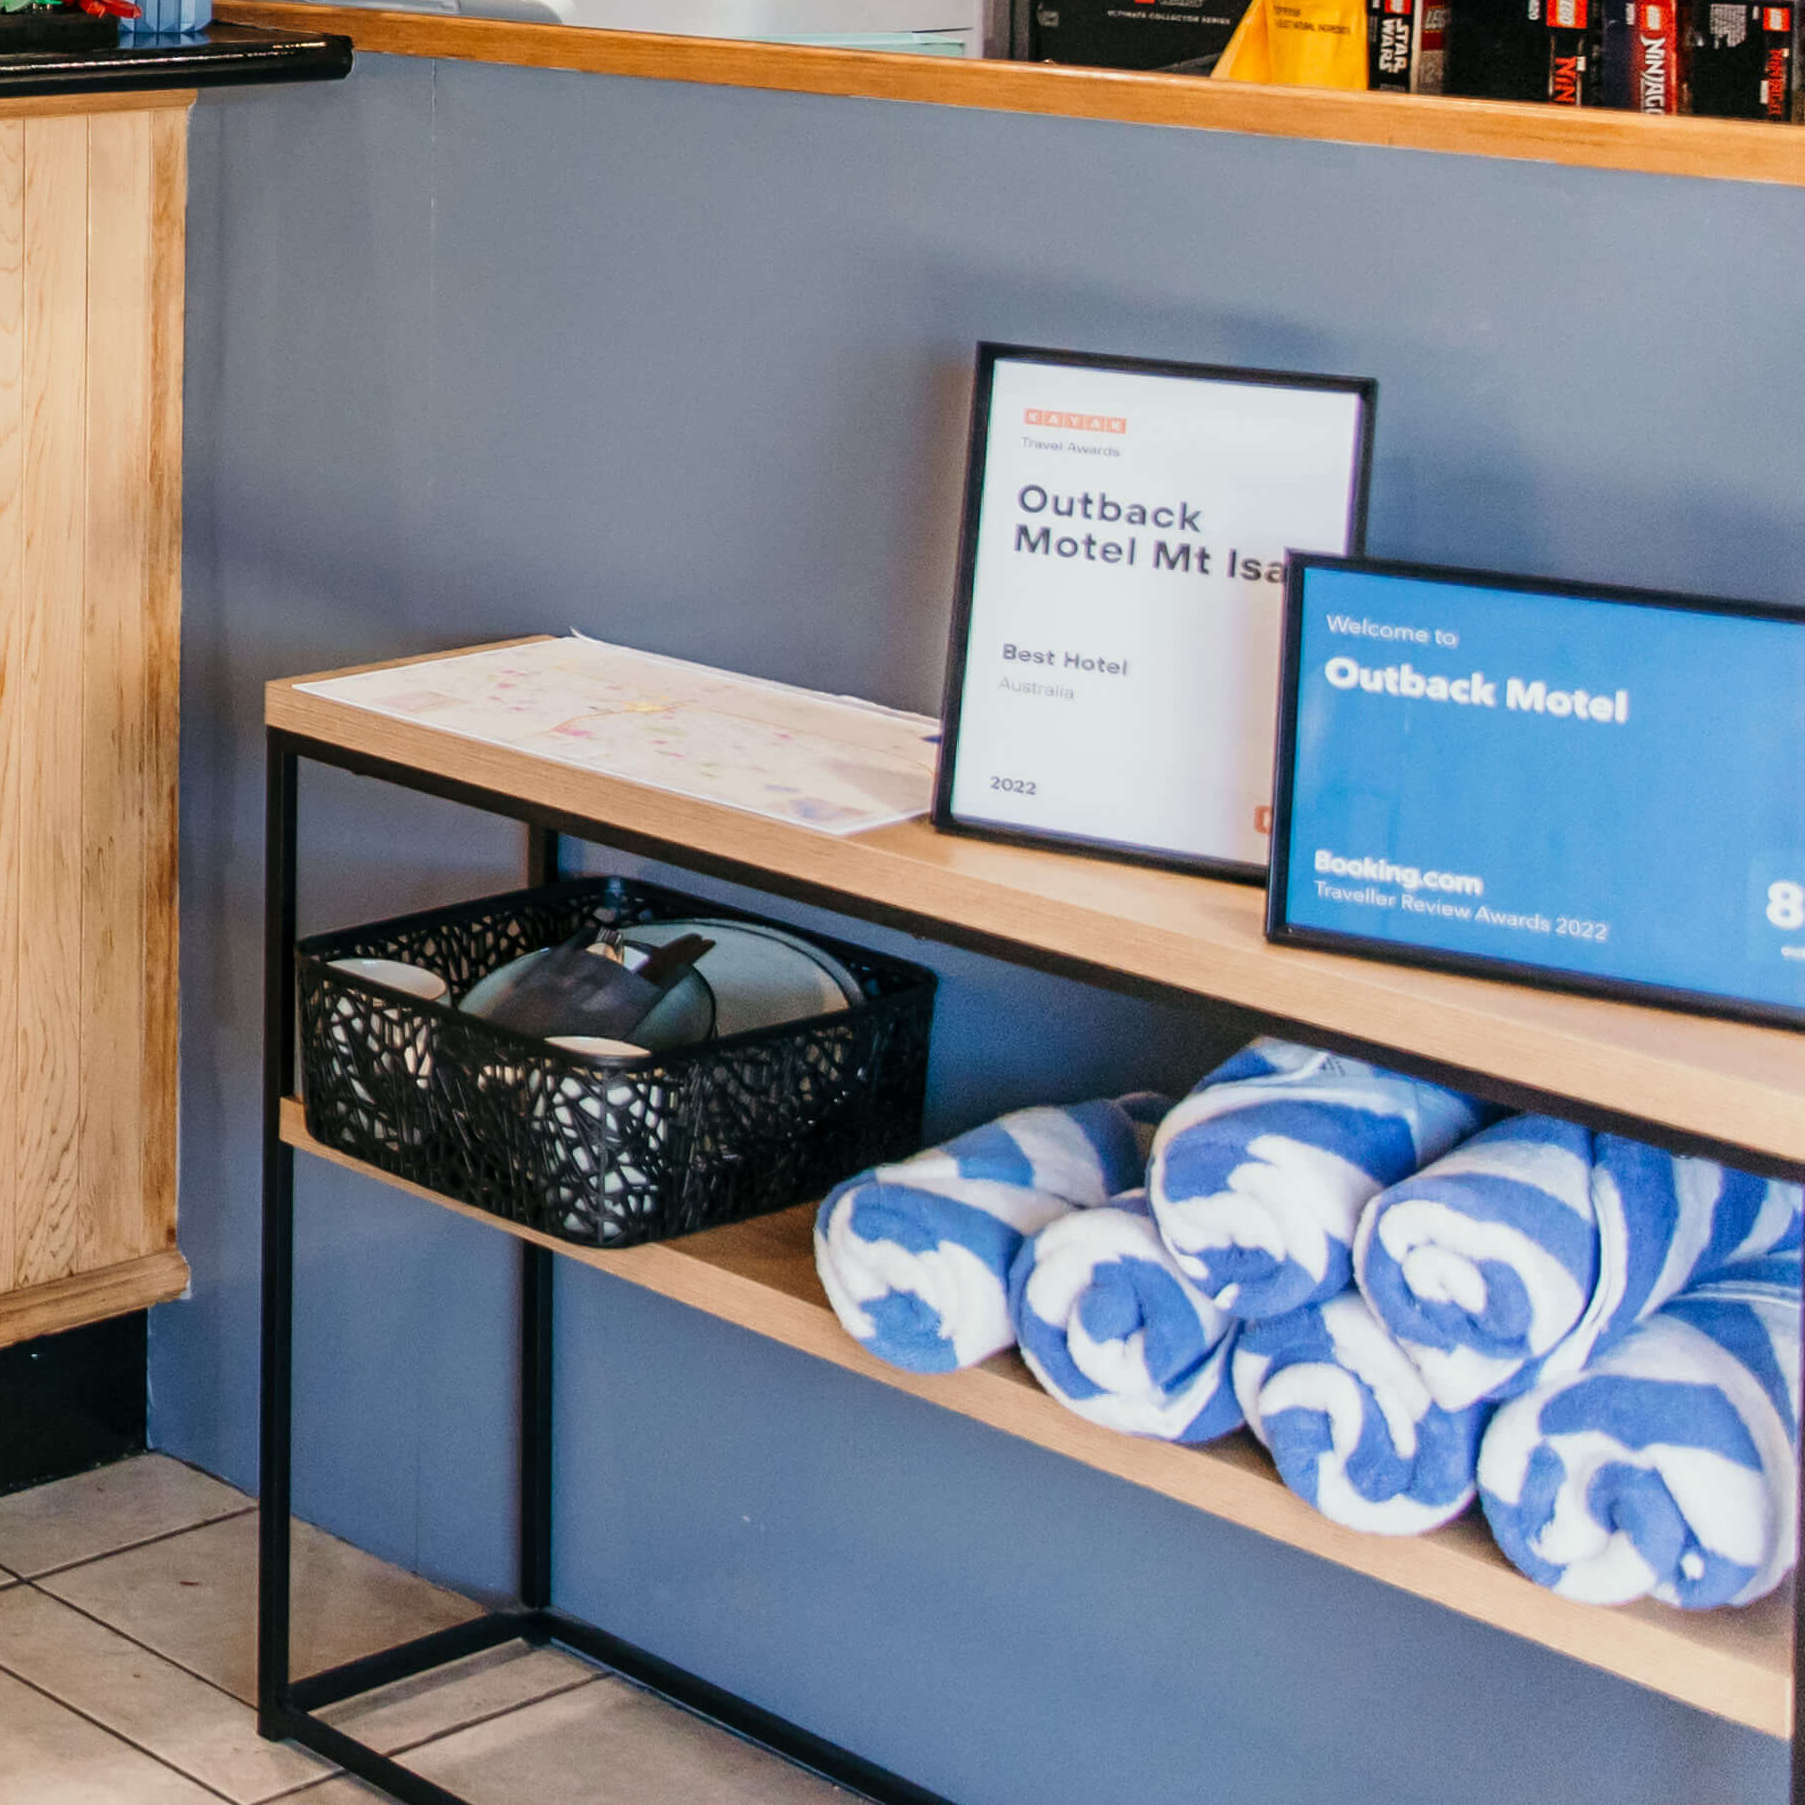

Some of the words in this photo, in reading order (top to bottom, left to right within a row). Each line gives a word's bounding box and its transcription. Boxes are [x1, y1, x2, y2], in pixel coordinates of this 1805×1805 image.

[1378, 18, 1397, 71] WARS
[1394, 18, 1410, 74] STAR
[1026, 410, 1124, 433] KAYAK
[1021, 436, 1063, 452] Travel
[1068, 441, 1121, 458] Awards
[1018, 483, 1202, 533] Outback
[1013, 523, 1136, 566] Motel
[1153, 540, 1211, 576] Mt
[1326, 613, 1429, 644] Welcome
[1435, 628, 1459, 649] to
[1002, 643, 1055, 666] Best
[1063, 650, 1129, 676] Hotel
[998, 676, 1075, 700] Australia
[1324, 656, 1496, 707] Outback
[1506, 677, 1629, 725] Motel
[990, 776, 1037, 796] 2022
[1314, 849, 1484, 897] Booking.com
[1314, 880, 1397, 908] Traveller
[1401, 894, 1471, 920] Review
[1475, 905, 1551, 934] Awards
[1556, 917, 1608, 941] 2022
